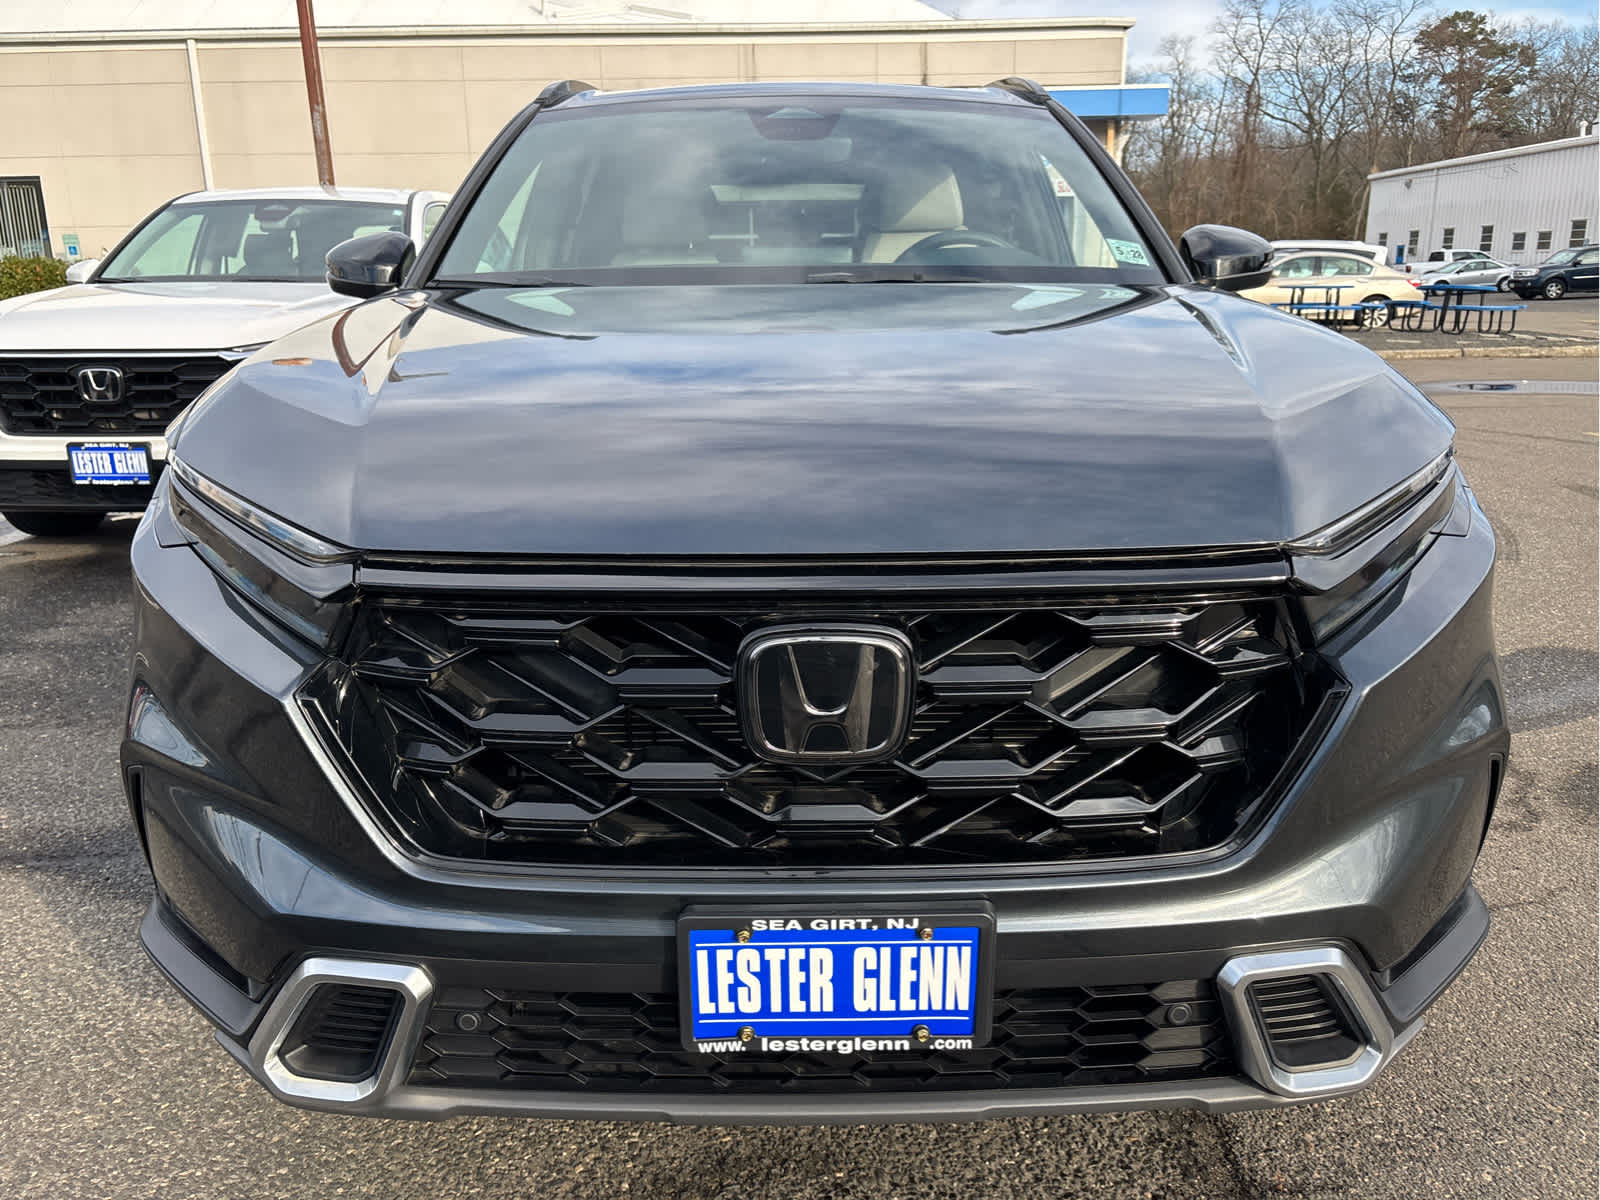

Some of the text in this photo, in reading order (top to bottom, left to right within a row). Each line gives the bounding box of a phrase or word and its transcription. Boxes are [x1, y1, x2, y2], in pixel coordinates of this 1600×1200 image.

[72, 452, 149, 474] LESTER GLENN
[751, 918, 919, 931] SEA GIRT, NJ
[696, 946, 972, 1014] LESTER GLENN
[697, 1037, 973, 1054] www. lesterglenn .com
